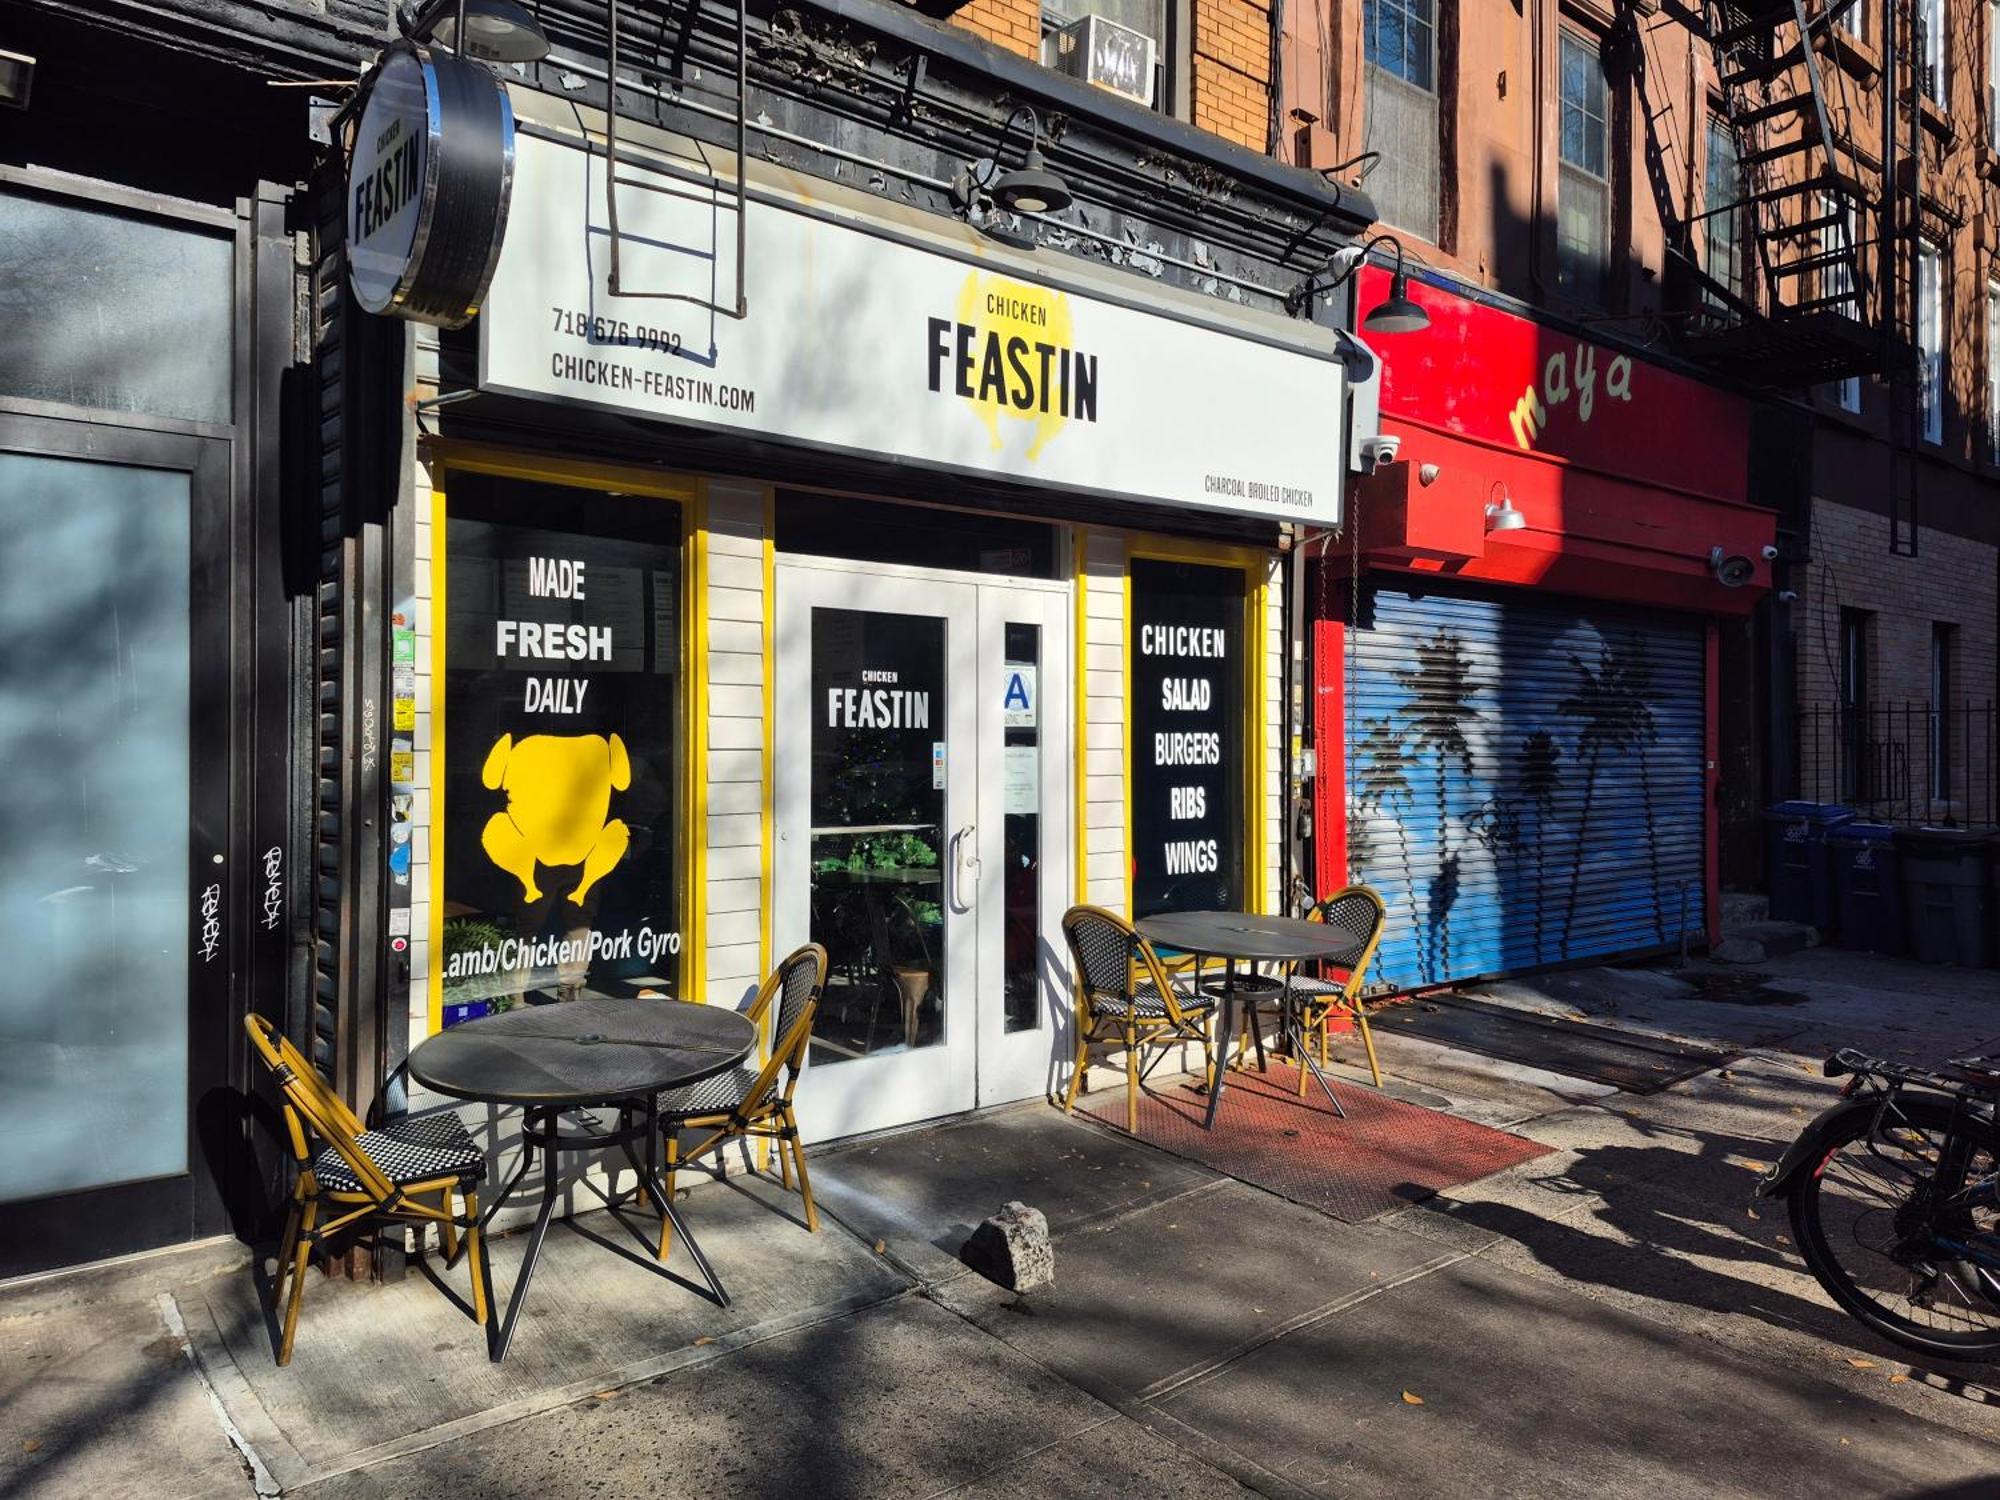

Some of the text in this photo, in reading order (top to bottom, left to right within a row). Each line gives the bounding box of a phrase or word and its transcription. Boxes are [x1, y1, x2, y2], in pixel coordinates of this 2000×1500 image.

[377, 118, 401, 154] CHICKEN
[355, 128, 420, 247] FEASTIN
[987, 293, 1047, 327] CHICKEN
[552, 307, 682, 356] 718 676 9992
[552, 353, 755, 413] CHICKEN-FEASTIN.COM
[928, 316, 1098, 423] FEASTIN
[1509, 343, 1633, 450] maya
[1204, 474, 1313, 508] CHARCOAL BROILED CHICKEN
[529, 556, 586, 601] MADE
[496, 620, 613, 661] FRESH
[1141, 624, 1226, 658] CHICKEN
[523, 677, 589, 714] DAILY
[862, 670, 898, 684] CHICKEN
[1004, 673, 1030, 709] A
[1162, 677, 1211, 711] SALAD
[828, 688, 929, 730] FEASTIN
[1155, 732, 1220, 766] BURGERS
[1170, 786, 1206, 820] RIBS
[1164, 839, 1218, 876] WINGS
